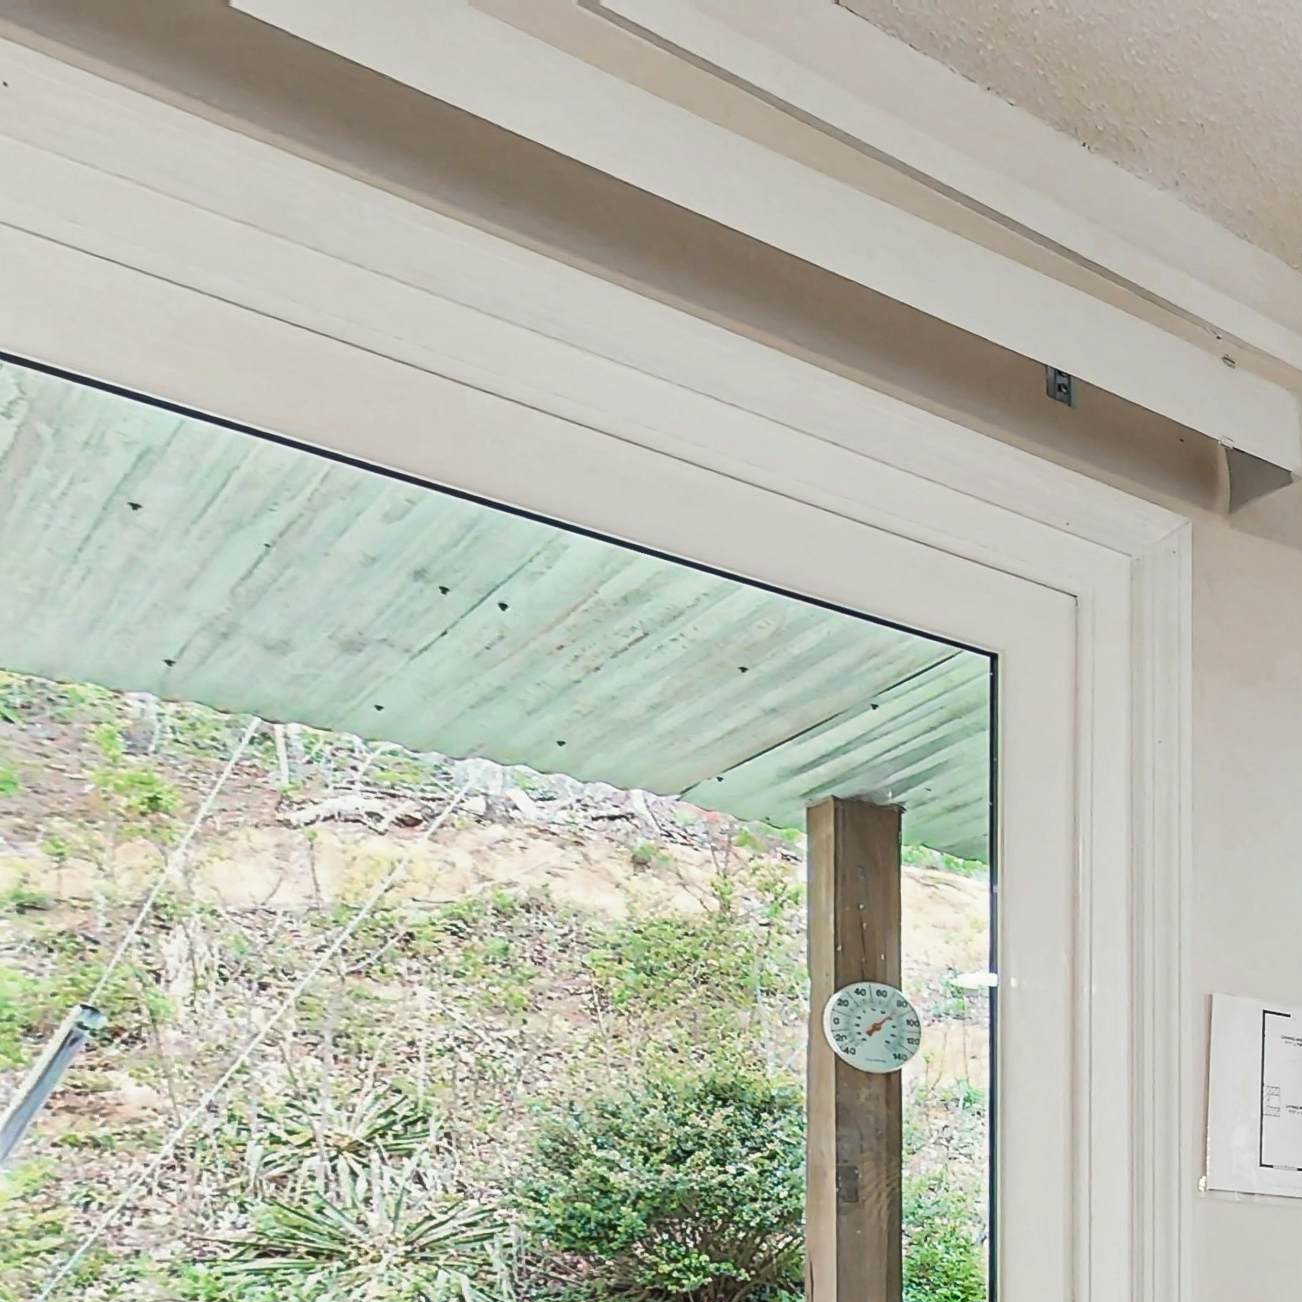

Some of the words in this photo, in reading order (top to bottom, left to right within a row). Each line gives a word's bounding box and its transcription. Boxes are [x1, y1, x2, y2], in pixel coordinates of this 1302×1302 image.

[854, 988, 866, 996] 40
[876, 989, 887, 997] 60
[837, 998, 849, 1006] 20
[896, 1000, 908, 1008] 80
[906, 1019, 920, 1027] 100
[893, 1053, 908, 1061] 140
